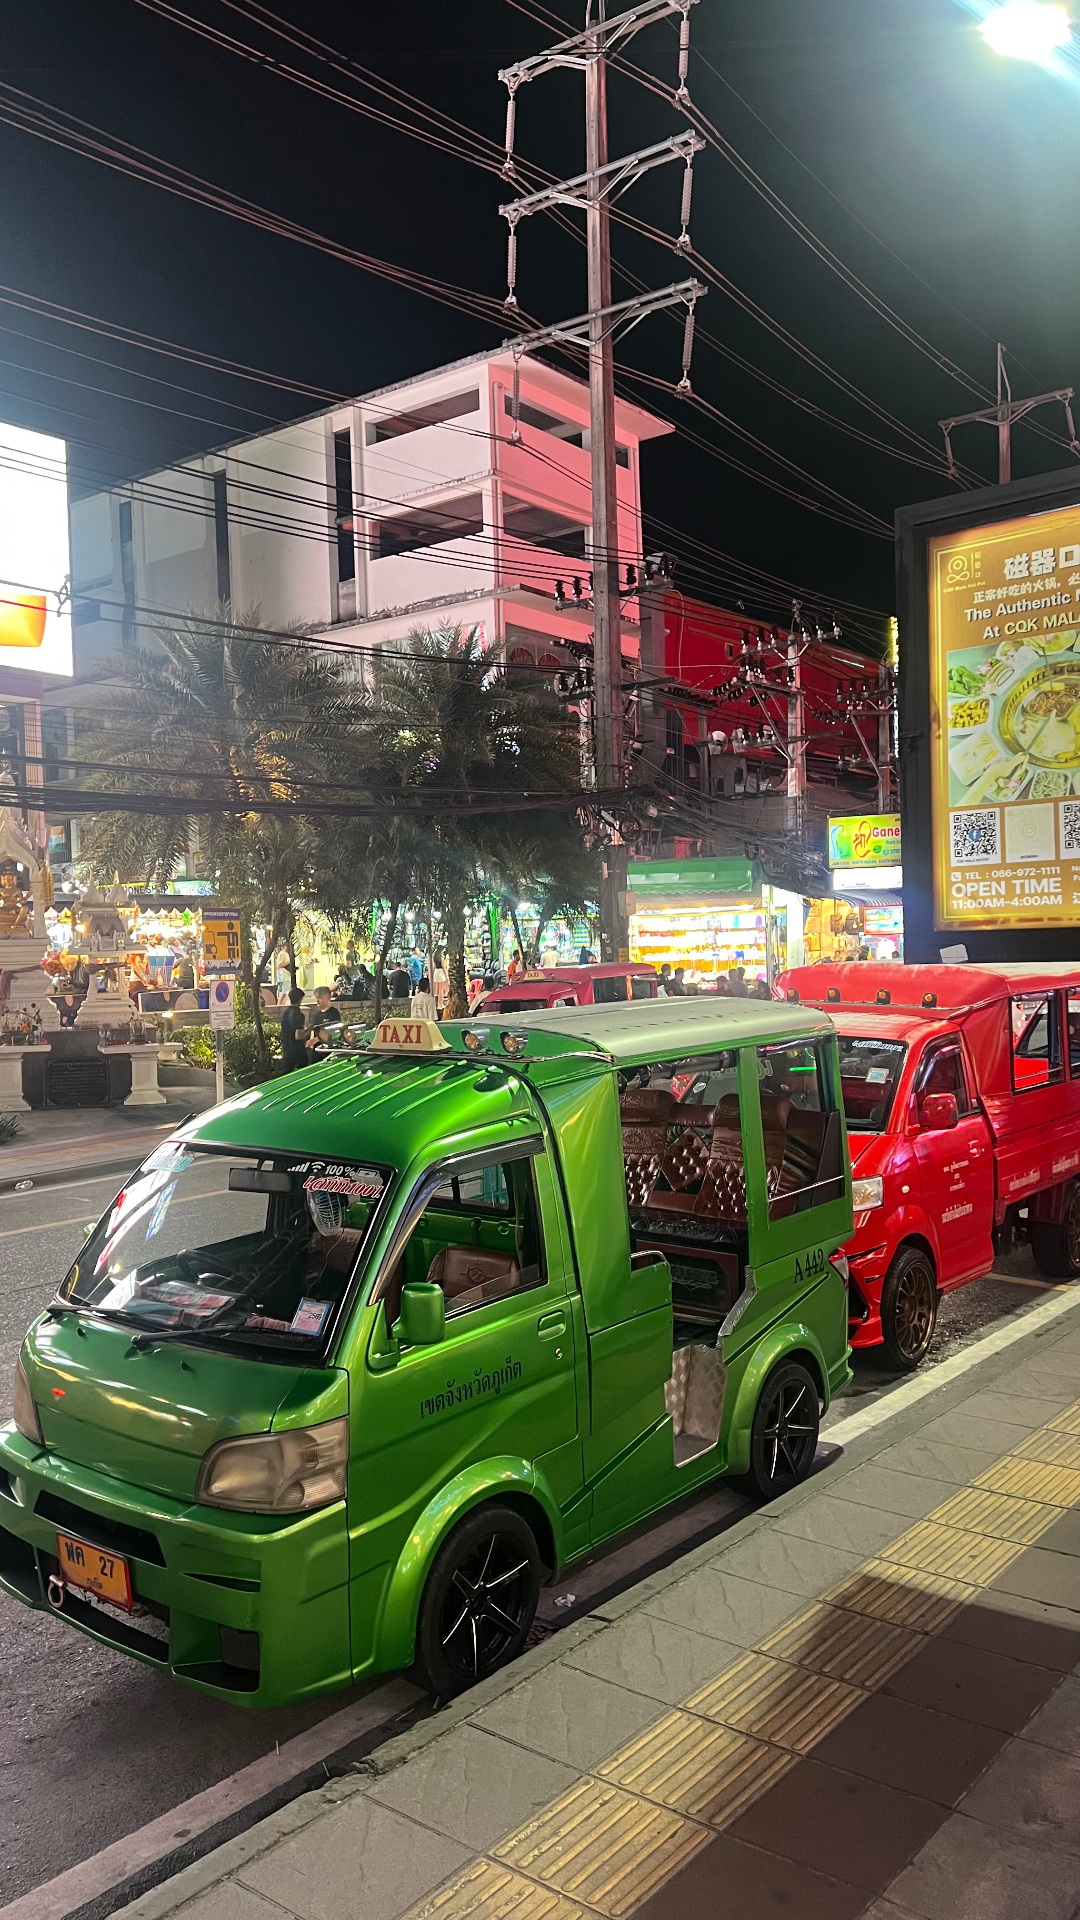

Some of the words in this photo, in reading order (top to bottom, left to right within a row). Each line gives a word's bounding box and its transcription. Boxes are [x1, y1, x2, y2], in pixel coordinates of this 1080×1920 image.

[964, 608, 992, 622] The
[996, 592, 1071, 617] Authentic
[983, 626, 1000, 639] At
[1004, 618, 1039, 635] CQK
[872, 826, 900, 837] Gane
[965, 872, 981, 880] TEL
[991, 866, 1060, 878] 086-972-1111
[951, 880, 1006, 897] OPEN
[1012, 877, 1062, 894] TIME
[951, 895, 1062, 909] 11:00AM-4:00AM
[379, 1024, 423, 1044] TAXI
[793, 1257, 804, 1284] A
[805, 1248, 825, 1278] 442
[420, 1355, 522, 1419] เขตจังหวัดภูเก็ต
[98, 1555, 115, 1579] 27
